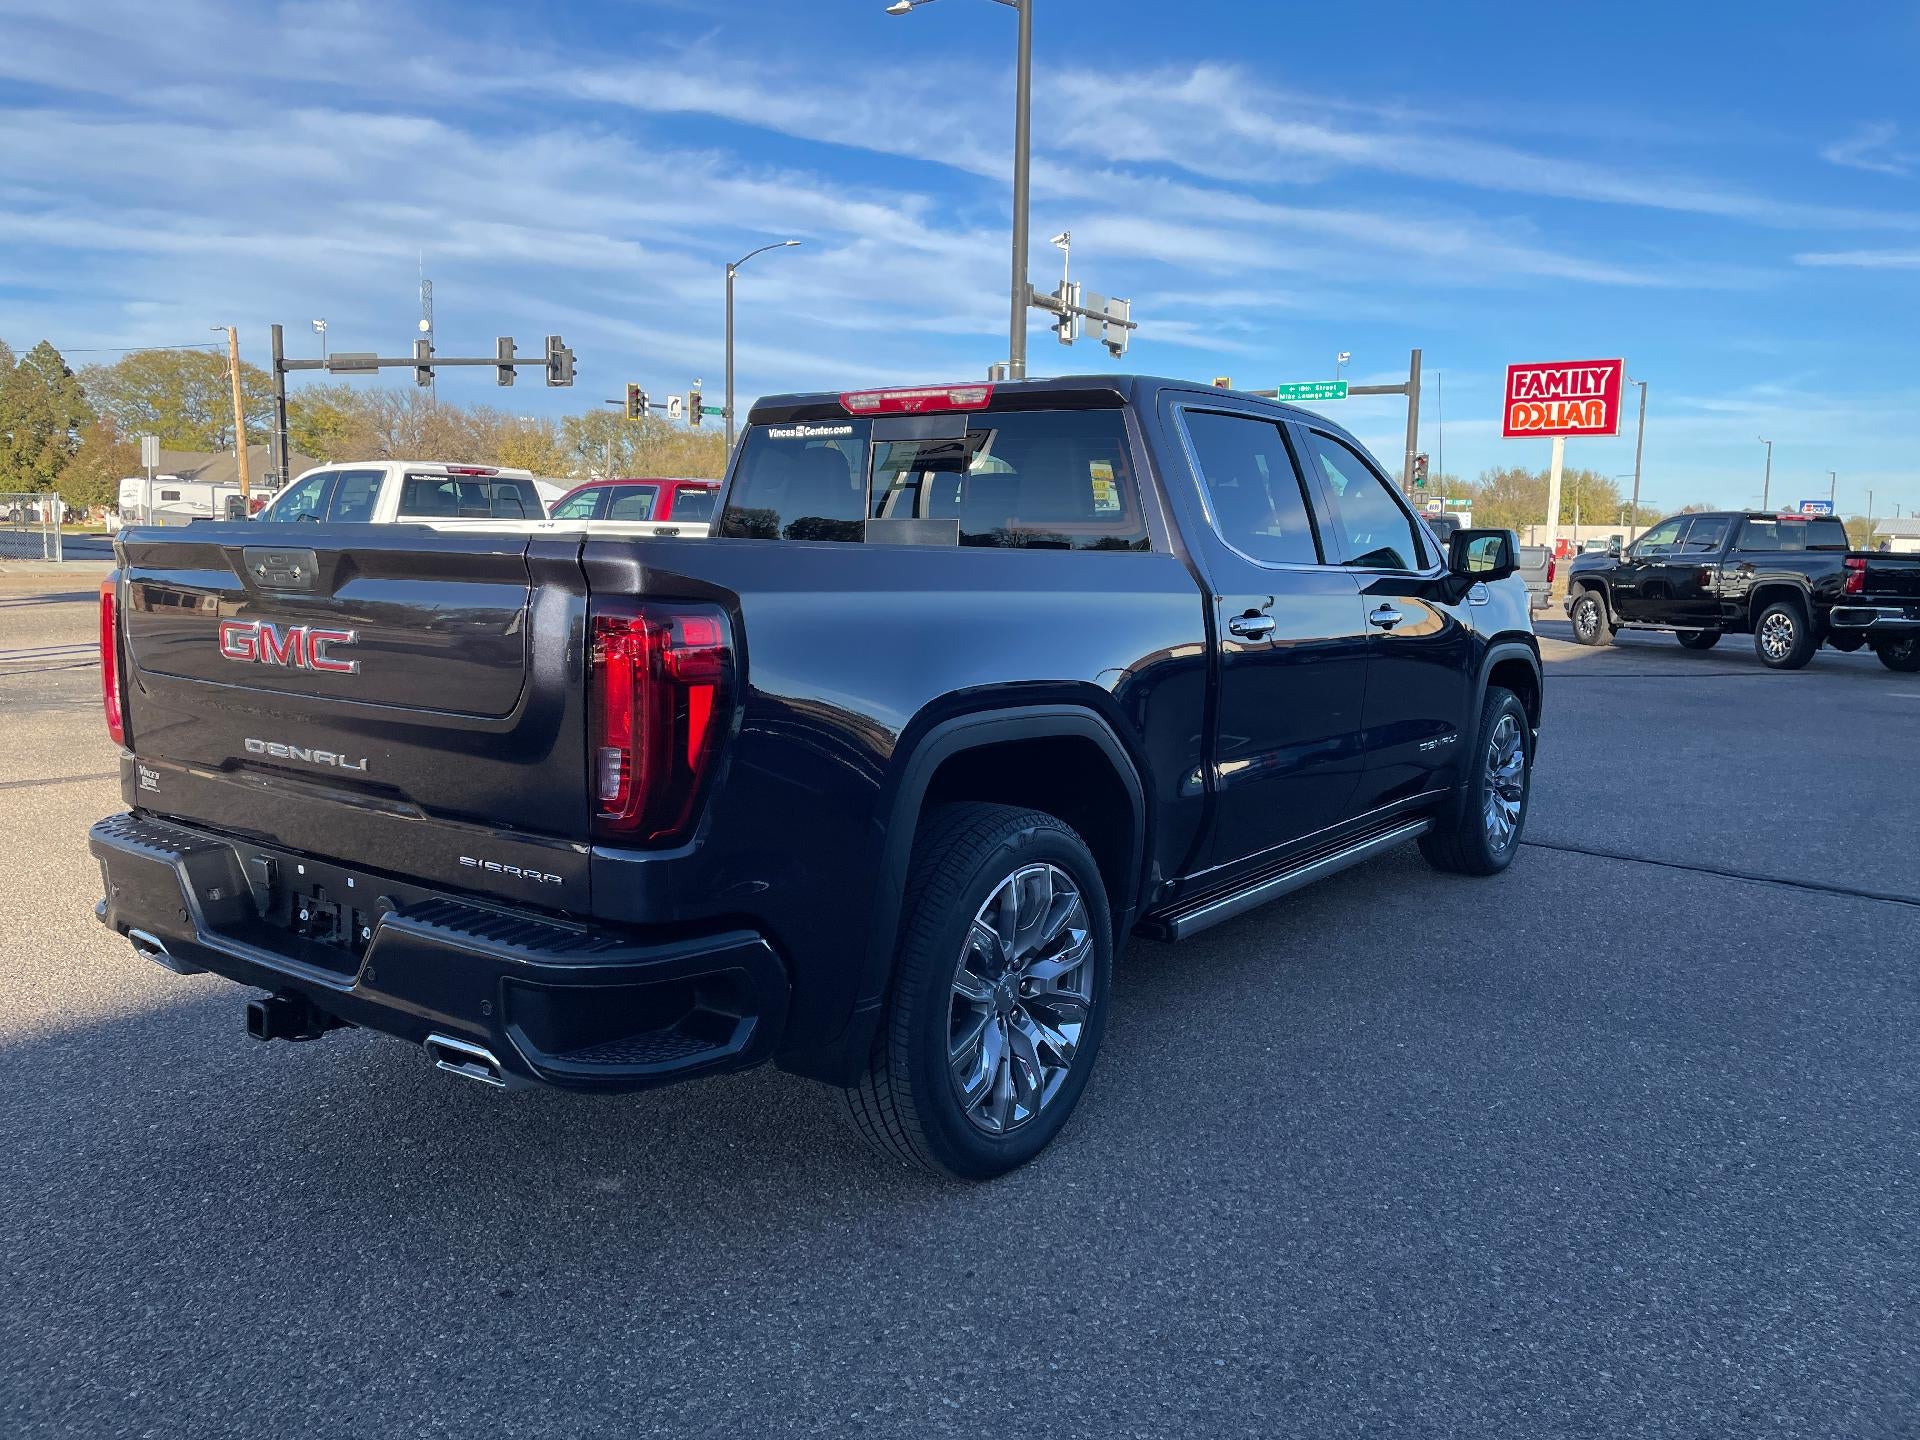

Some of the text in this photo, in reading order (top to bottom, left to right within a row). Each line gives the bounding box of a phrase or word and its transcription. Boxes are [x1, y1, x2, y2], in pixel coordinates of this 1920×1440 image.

[1324, 390, 1334, 398] Dr
[1511, 366, 1613, 399] FAMILY
[1509, 399, 1606, 430] DOLLAR
[219, 618, 360, 675] GMC
[244, 738, 367, 771] DENALI
[1419, 734, 1458, 751] DENALI
[459, 856, 563, 884] SIERRA
